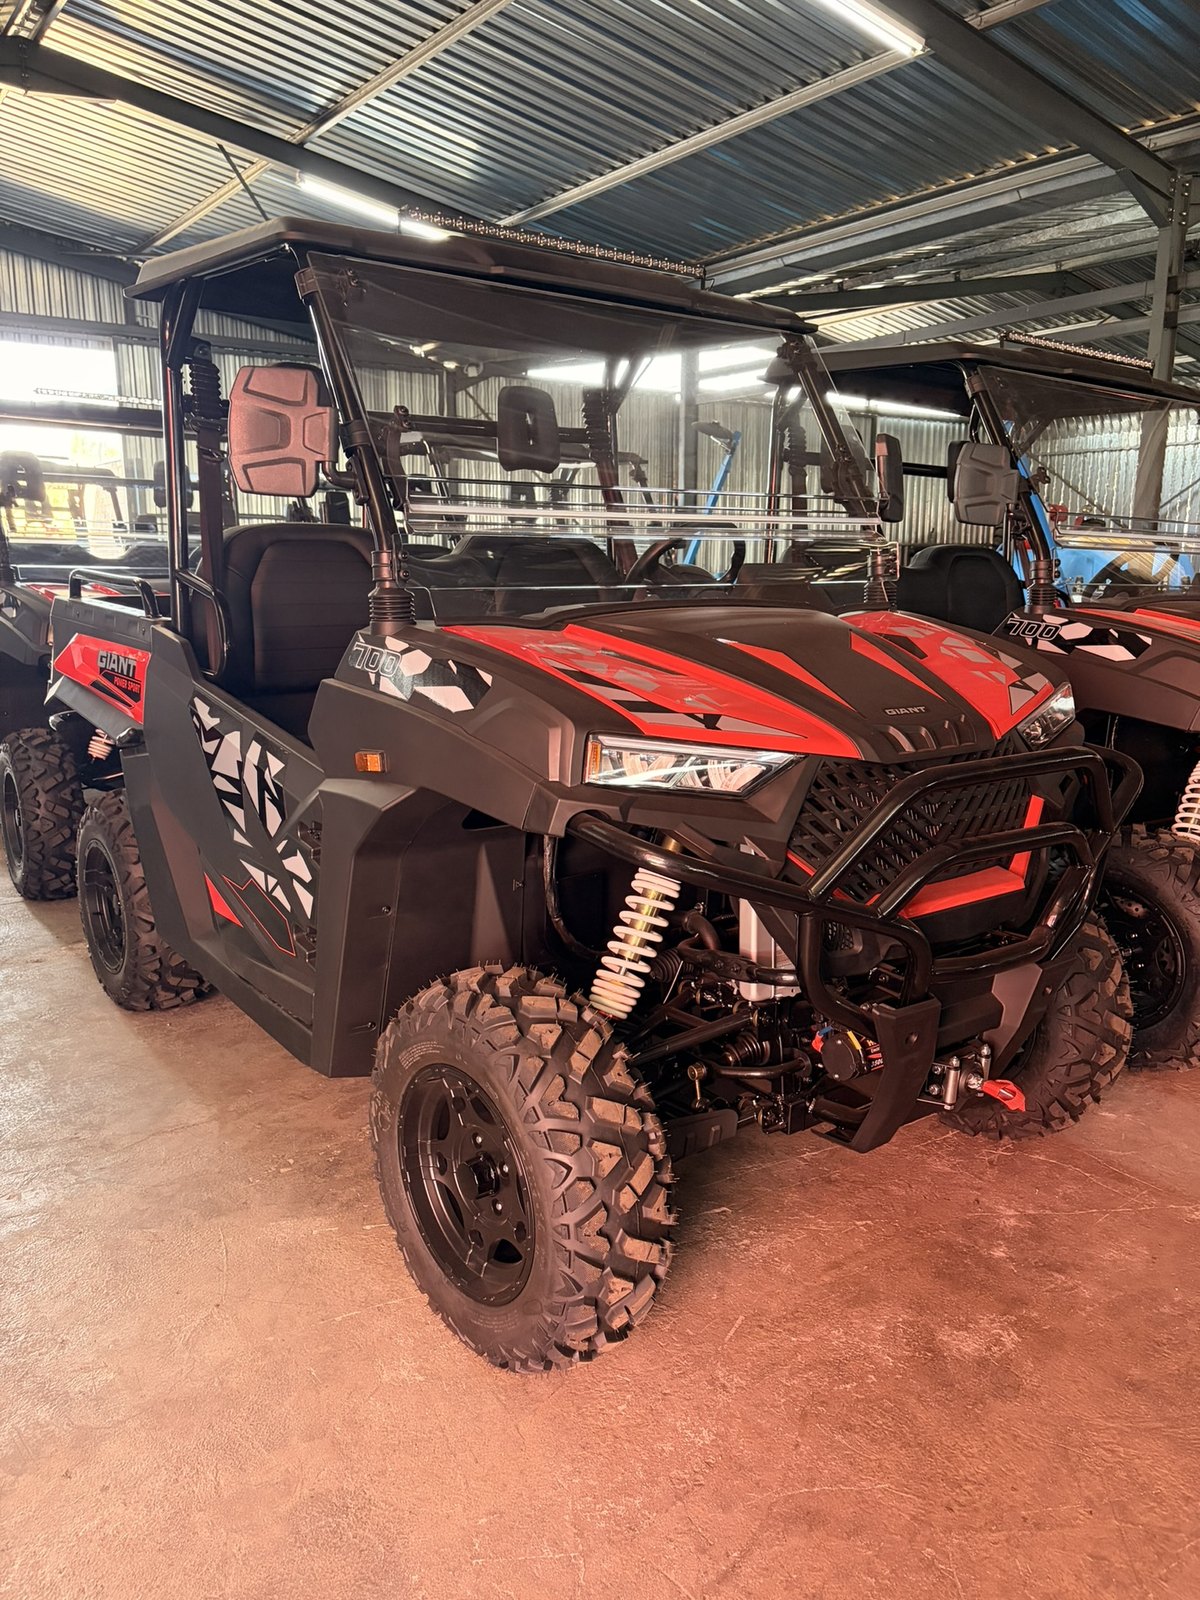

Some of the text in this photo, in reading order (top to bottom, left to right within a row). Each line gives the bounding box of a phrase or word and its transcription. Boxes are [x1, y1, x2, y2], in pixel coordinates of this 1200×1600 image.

[1006, 617, 1063, 641] 700
[97, 649, 137, 678] GIANT
[353, 641, 402, 678] 700
[113, 676, 141, 694] POWER SPORT
[884, 705, 926, 716] GIANT
